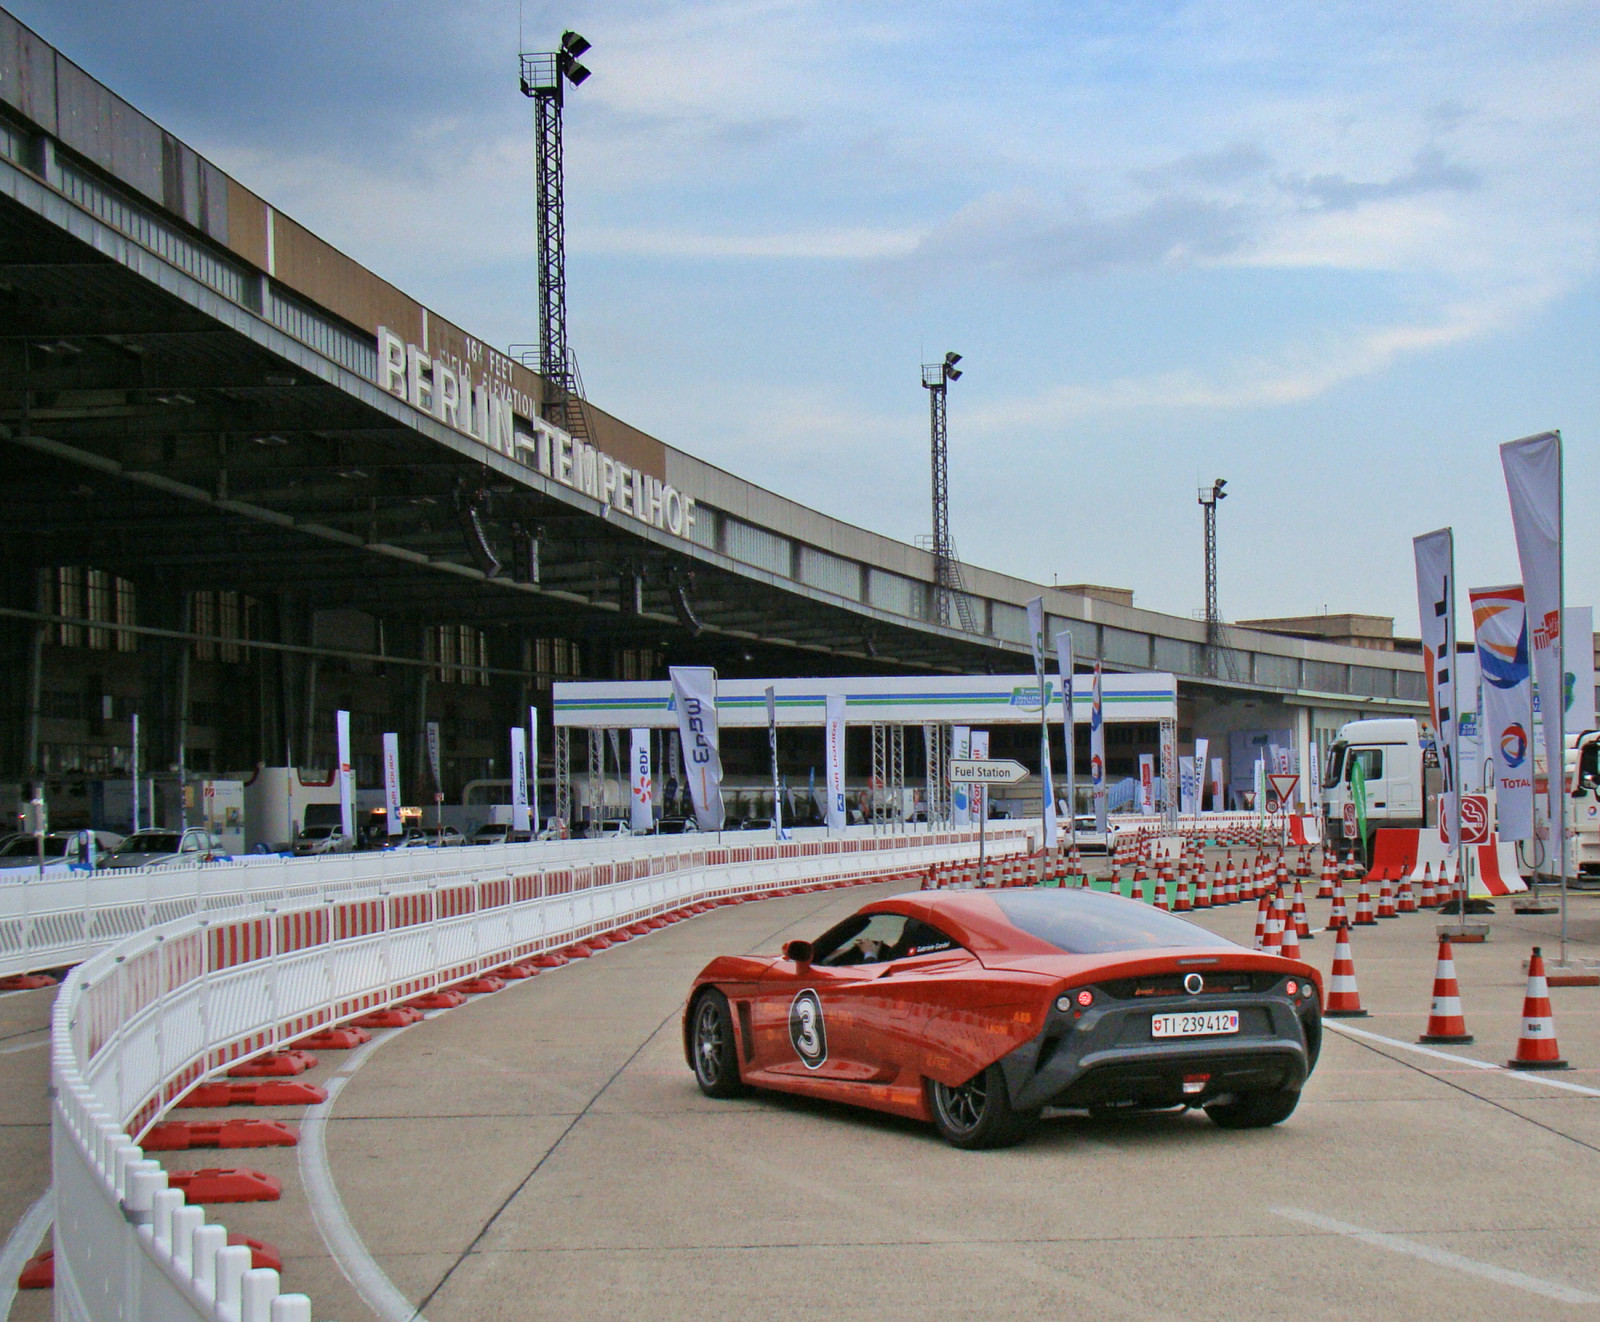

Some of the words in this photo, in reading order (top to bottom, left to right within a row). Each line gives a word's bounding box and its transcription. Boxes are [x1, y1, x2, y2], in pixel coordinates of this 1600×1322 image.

[490, 351, 513, 382] FEET
[377, 325, 697, 540] BERLIN-TEMPELHOF
[955, 766, 974, 777] Fuel
[977, 766, 1011, 778] Station
[1500, 777, 1531, 789] TOTAL
[796, 997, 821, 1058] 3
